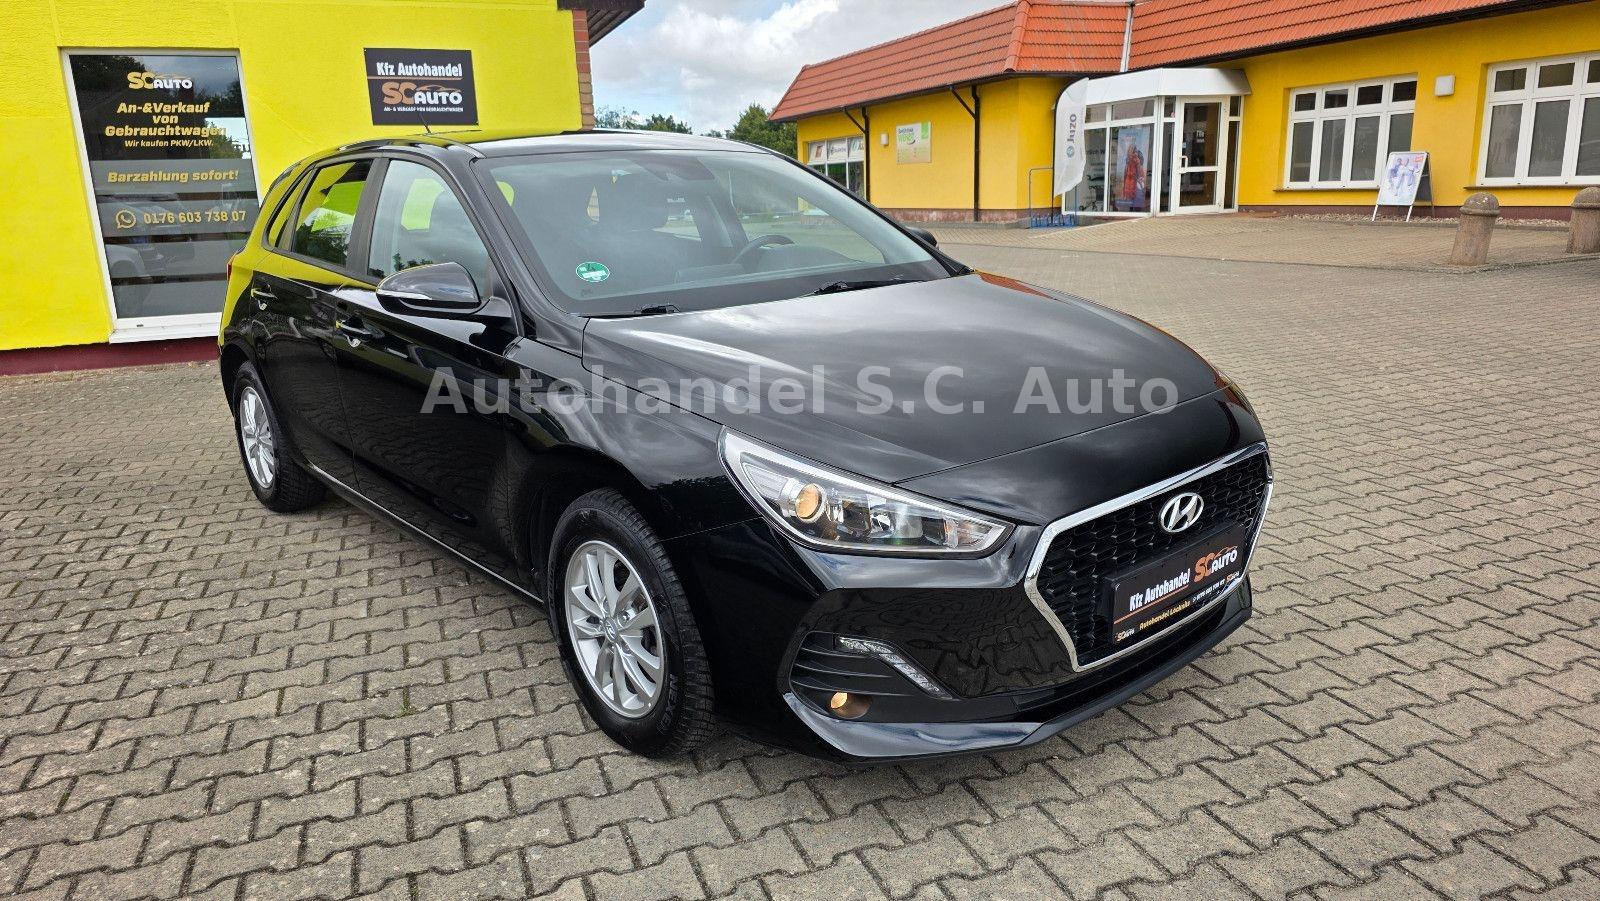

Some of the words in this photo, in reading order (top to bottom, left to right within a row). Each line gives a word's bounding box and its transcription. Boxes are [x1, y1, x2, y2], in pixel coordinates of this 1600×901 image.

[376, 61, 395, 76] Kfz
[398, 62, 463, 77] Autohandel
[117, 101, 210, 114] An-&Verkauf
[152, 115, 179, 125] von
[105, 124, 227, 138] Gebrauchtwagen
[1066, 113, 1078, 144] Juzo
[124, 139, 139, 147] Wir
[140, 139, 169, 147] kaufen
[107, 170, 189, 184] Barzahlung
[192, 169, 239, 182] sofort!
[143, 212, 175, 225] 0176
[178, 211, 202, 224] 603
[204, 210, 229, 223] 738
[231, 210, 247, 222] 07
[1129, 594, 1143, 612] Kfz
[1145, 568, 1191, 604] Autohandel
